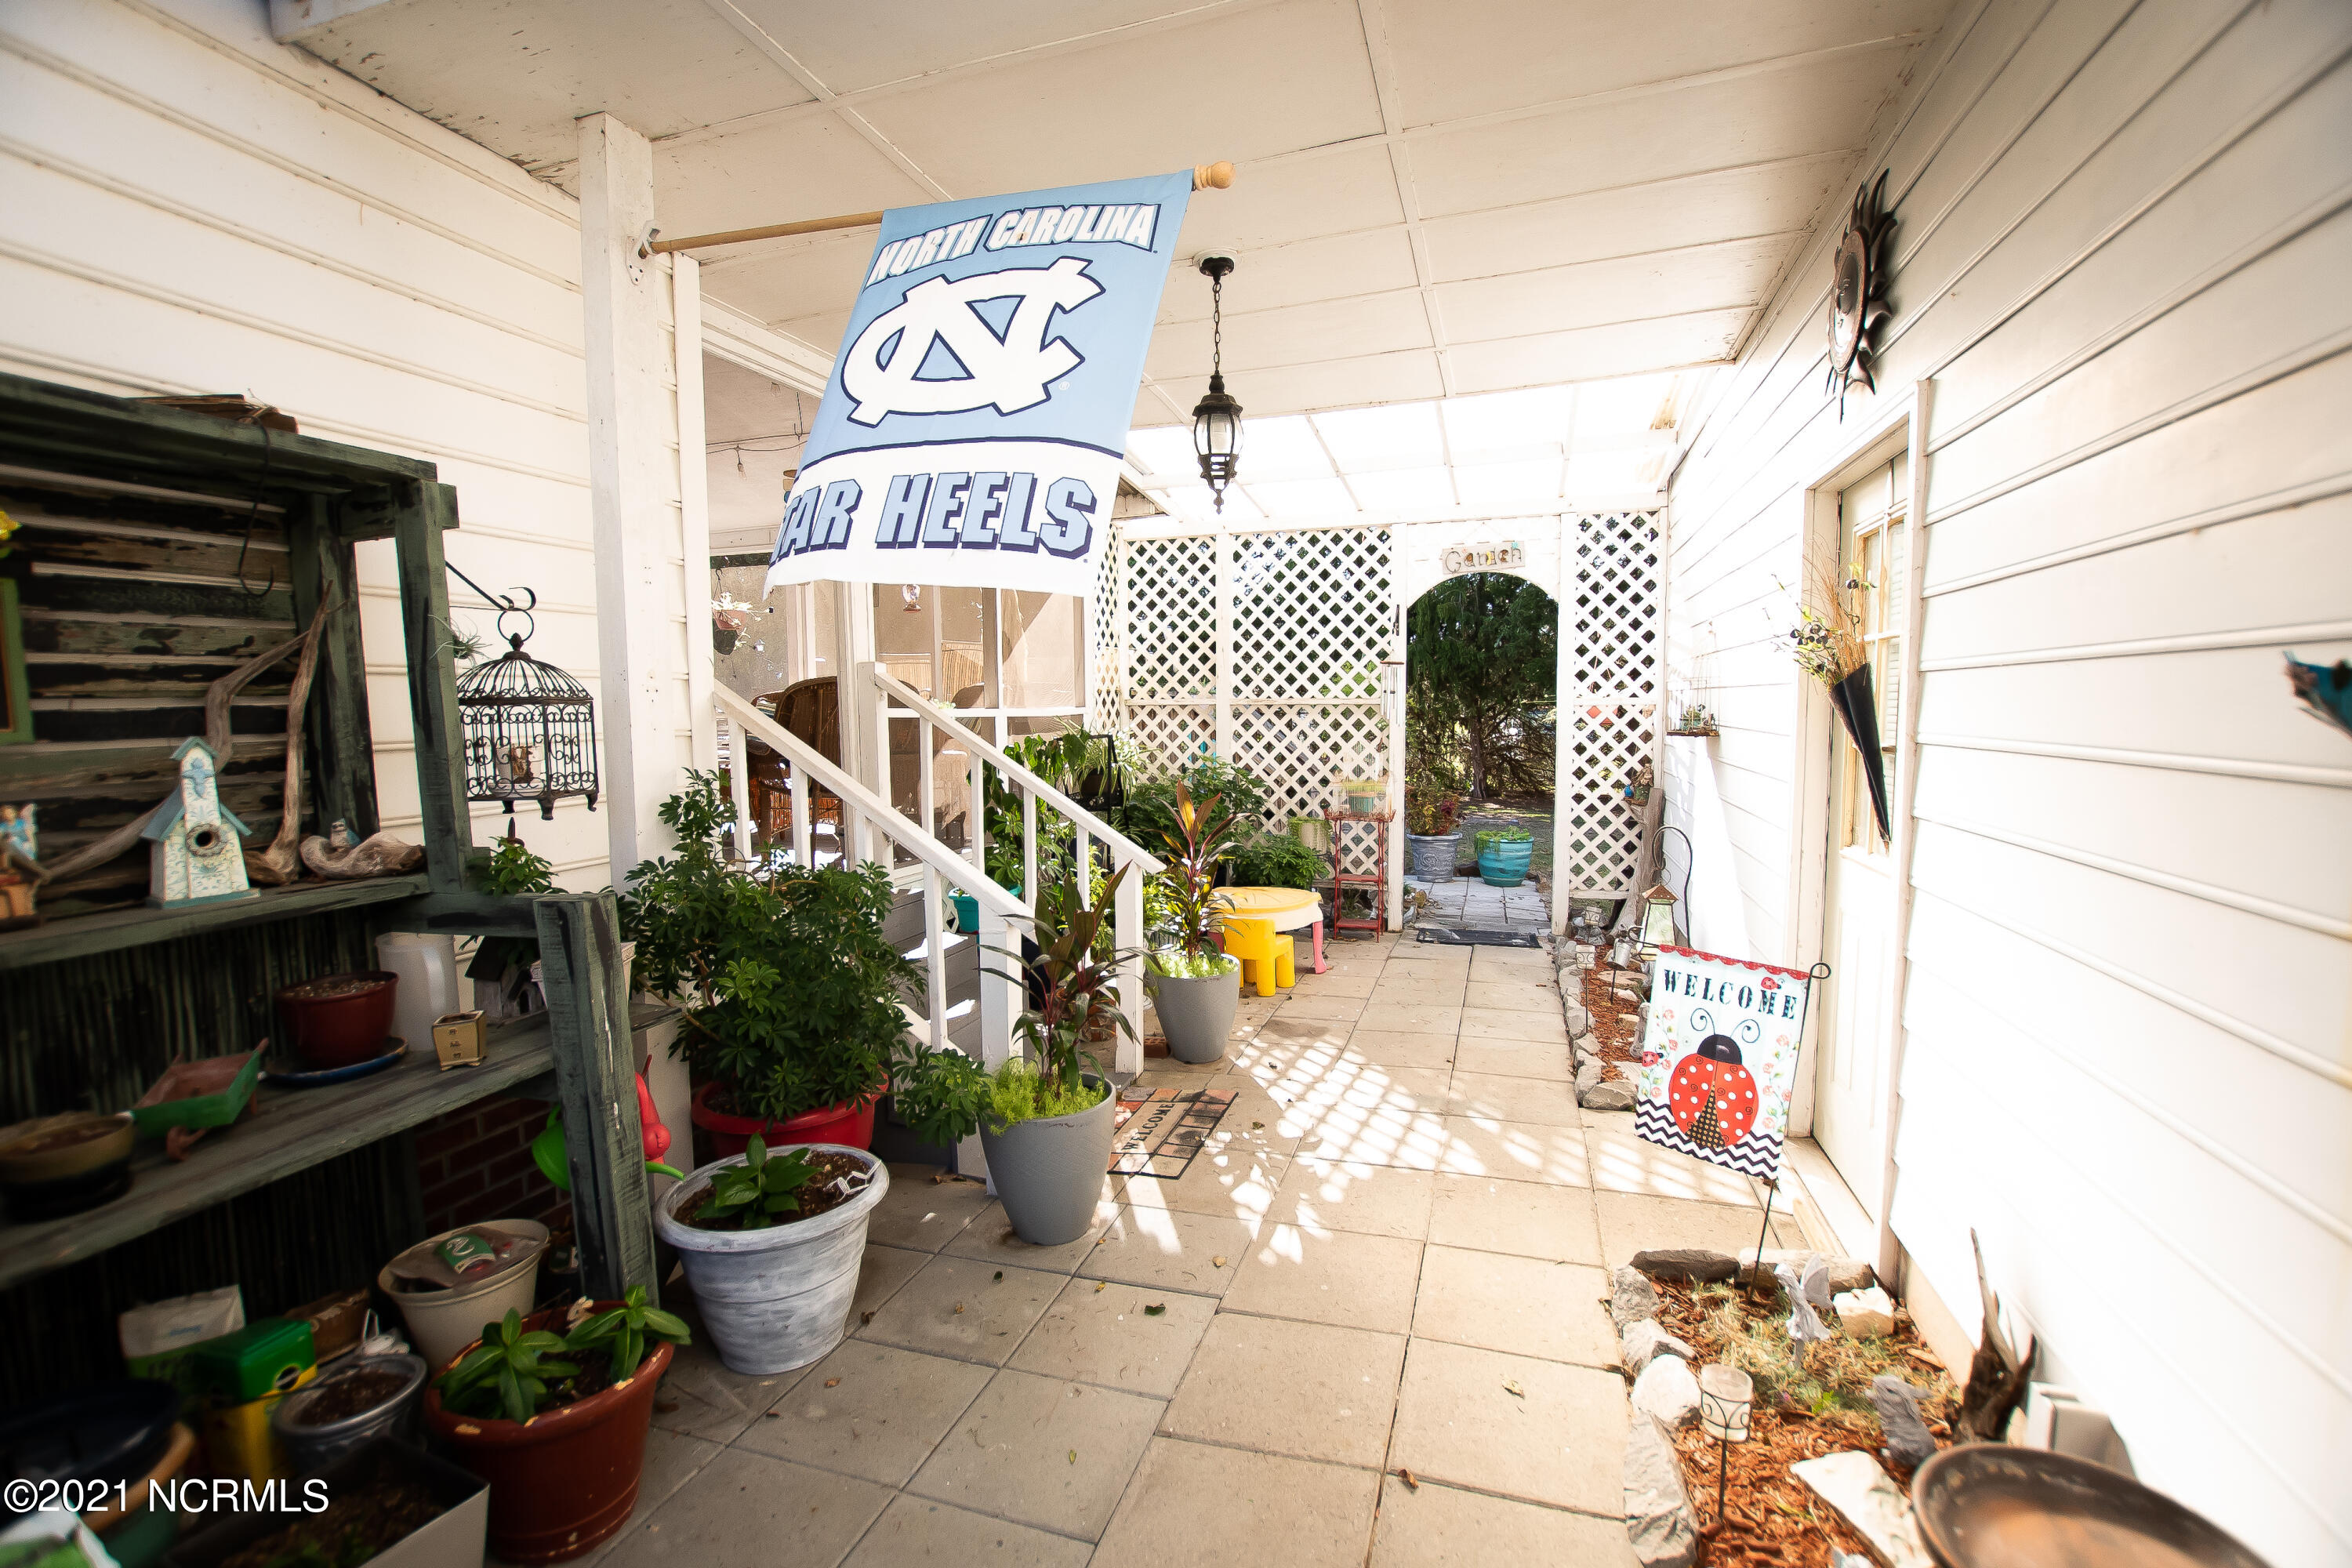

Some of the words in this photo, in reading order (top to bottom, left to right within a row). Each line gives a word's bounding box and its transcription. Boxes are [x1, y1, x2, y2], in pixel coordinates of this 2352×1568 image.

[865, 214, 993, 289] NORTH
[984, 203, 1162, 252] CAROLINA
[875, 472, 1097, 560] HEELS
[1664, 970, 1797, 1019] WELCOME
[1121, 1103, 1175, 1150] WELCOME
